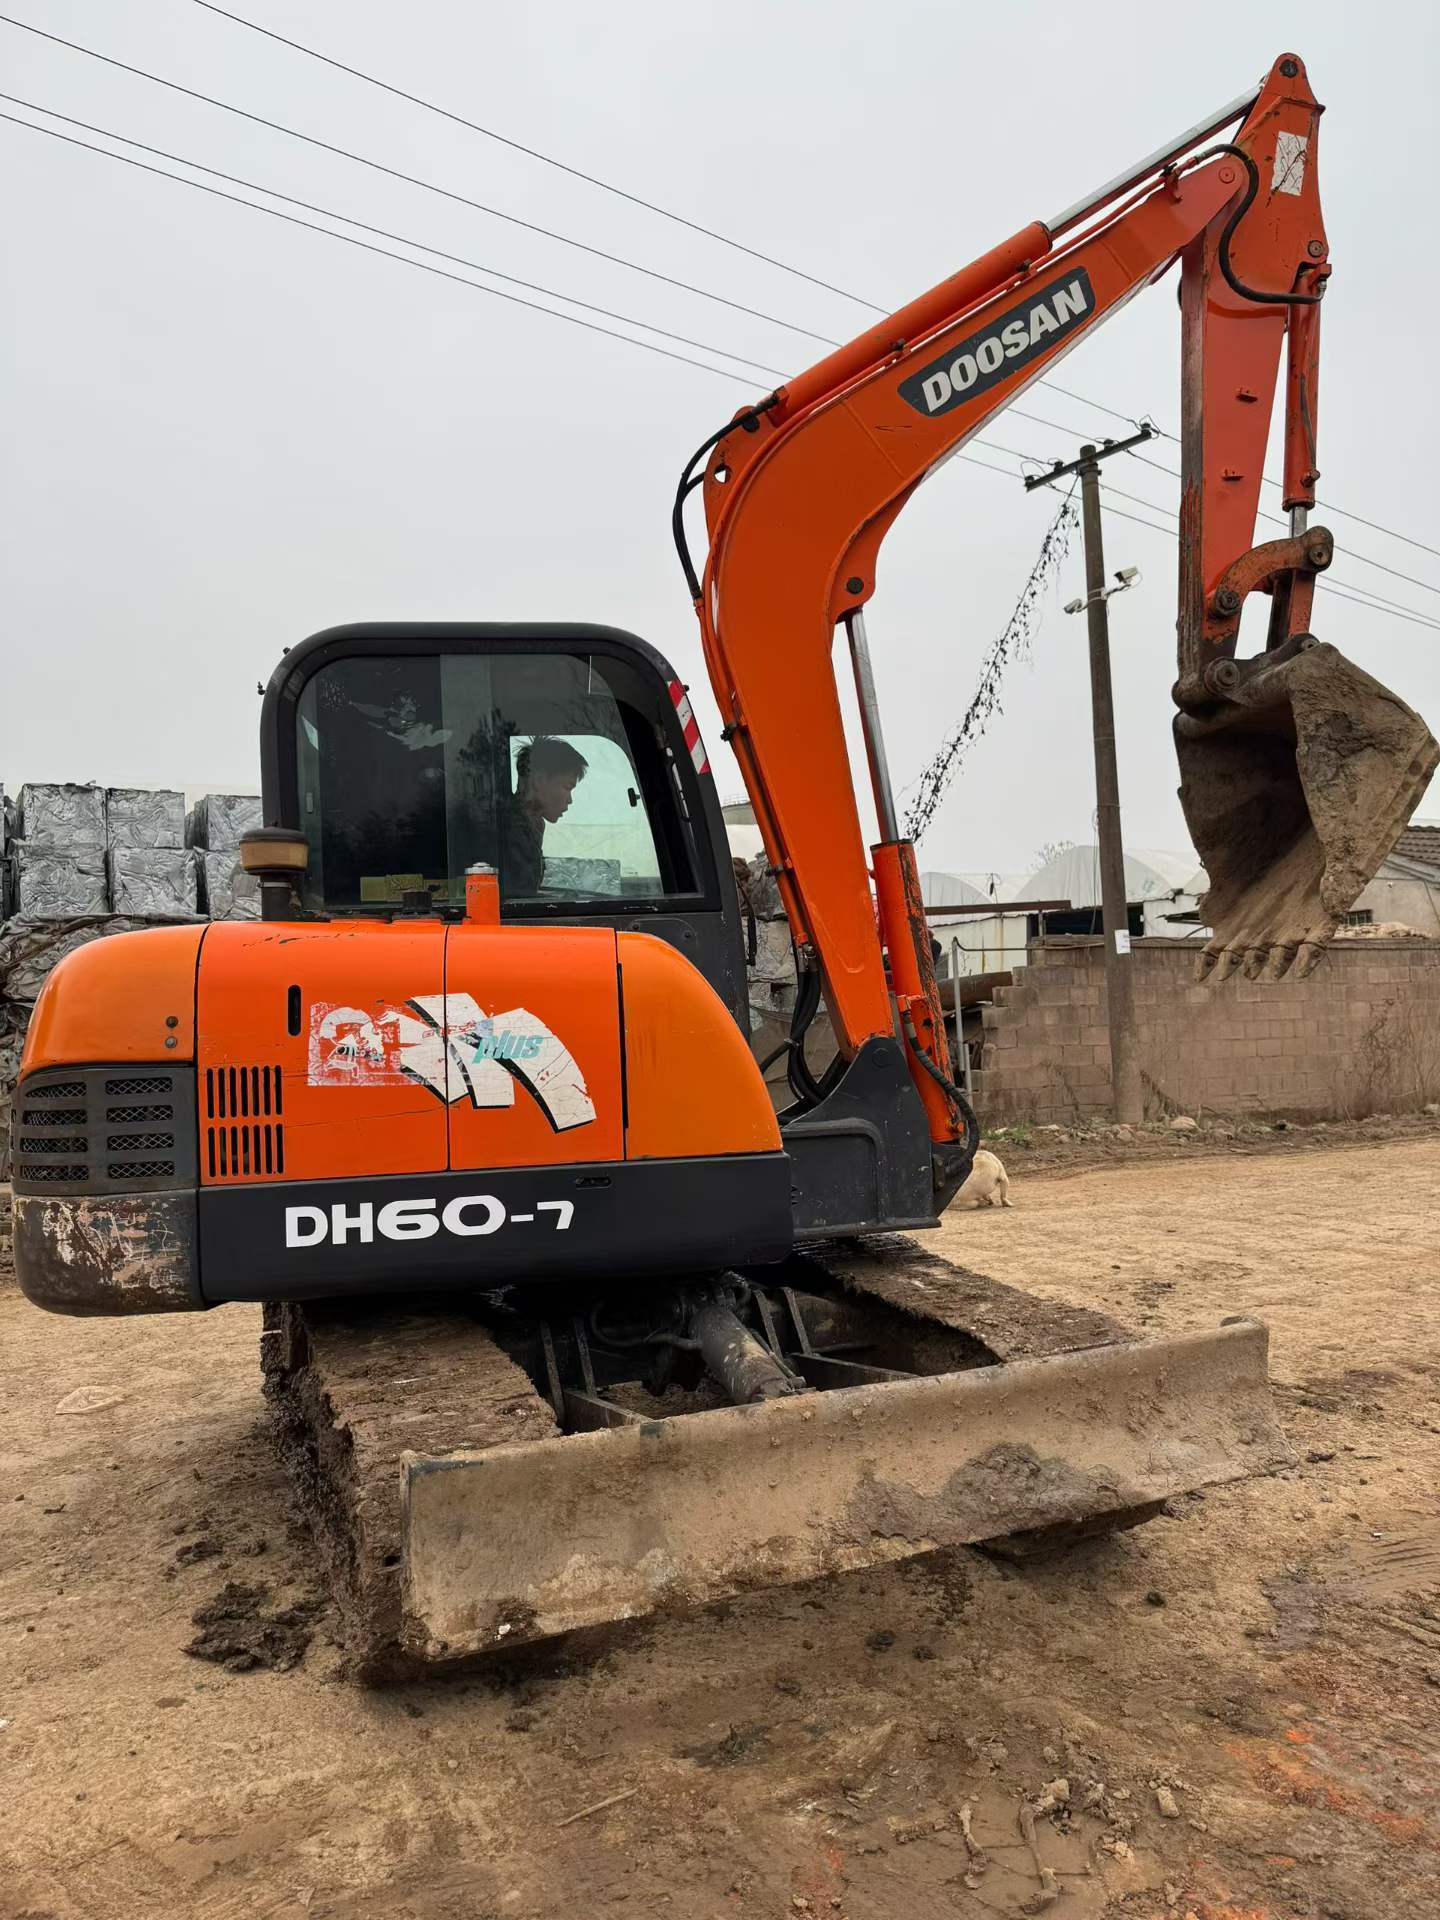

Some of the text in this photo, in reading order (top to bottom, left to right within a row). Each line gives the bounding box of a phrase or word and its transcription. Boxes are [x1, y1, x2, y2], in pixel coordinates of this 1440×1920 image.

[922, 279, 1087, 413] DOOSAN
[472, 1030, 544, 1064] plus
[285, 1195, 575, 1248] DH60-7
